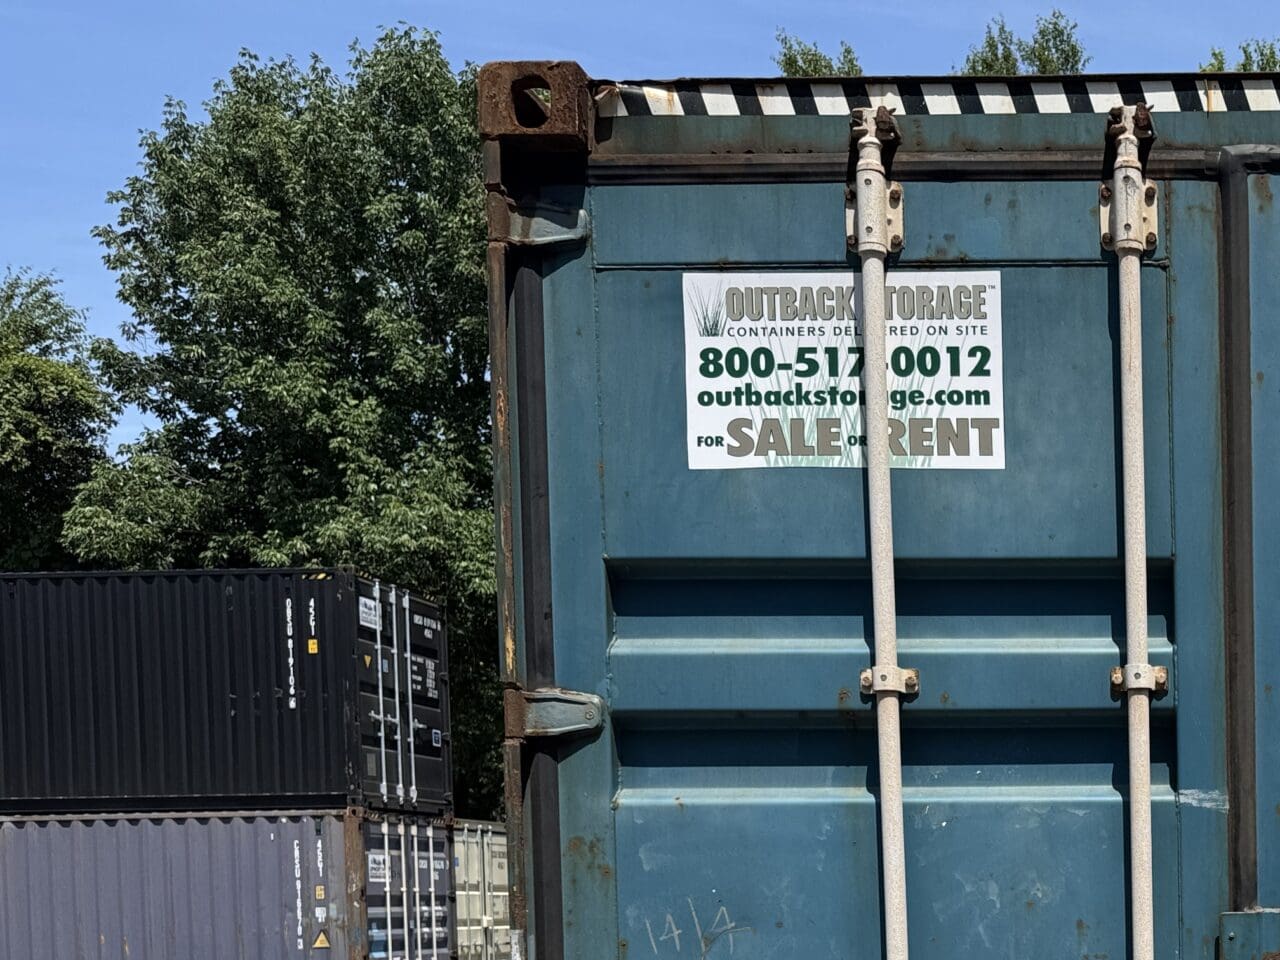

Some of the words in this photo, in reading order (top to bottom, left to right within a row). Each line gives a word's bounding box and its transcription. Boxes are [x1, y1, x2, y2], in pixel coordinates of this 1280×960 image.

[725, 286, 857, 321] OUTBACK
[884, 285, 987, 320] TORAGE
[727, 326, 825, 337] CONTAINERS
[833, 325, 920, 337] DELRED
[926, 325, 949, 336] ON
[956, 325, 988, 336] SITE
[699, 346, 991, 378] 800-5170012
[697, 436, 724, 447] FOR
[726, 418, 842, 457] SALE
[887, 417, 1000, 456] RENT
